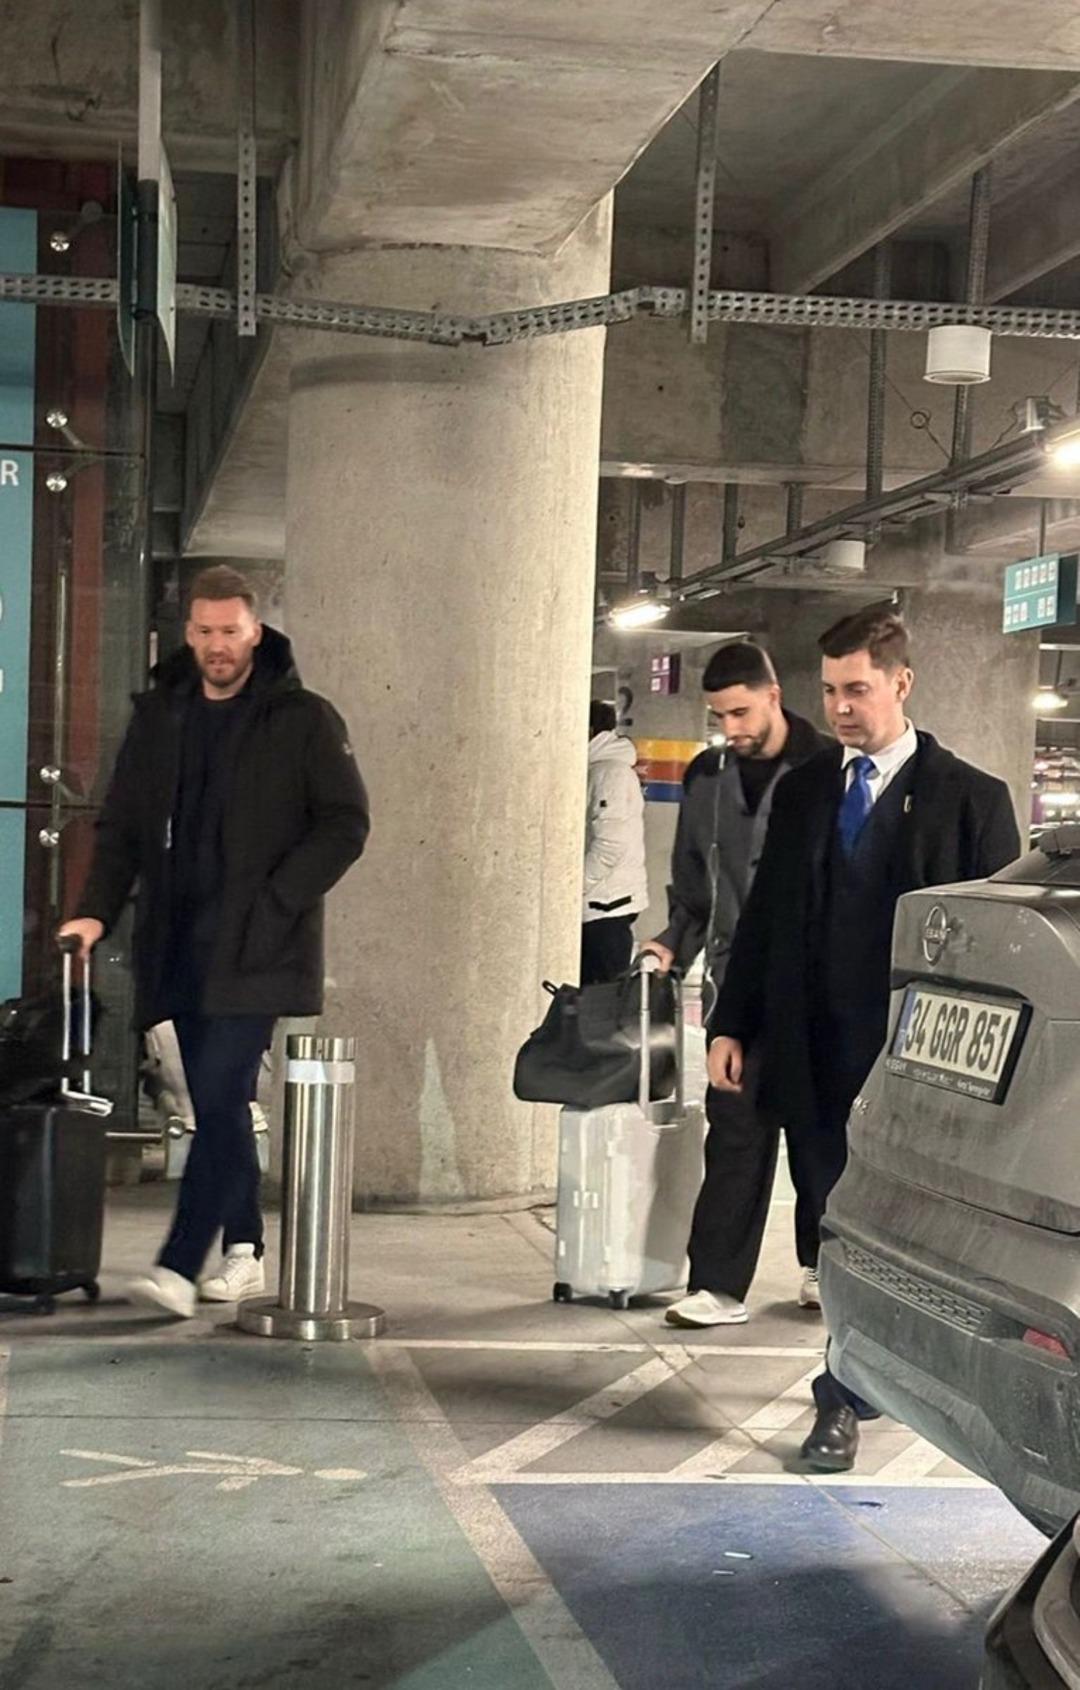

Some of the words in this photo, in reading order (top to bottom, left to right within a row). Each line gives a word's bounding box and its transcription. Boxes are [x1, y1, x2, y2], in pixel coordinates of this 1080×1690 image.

[1, 459, 19, 486] R
[904, 999, 932, 1055] 34
[929, 1002, 969, 1065] GGR
[966, 1010, 1012, 1075] 851
